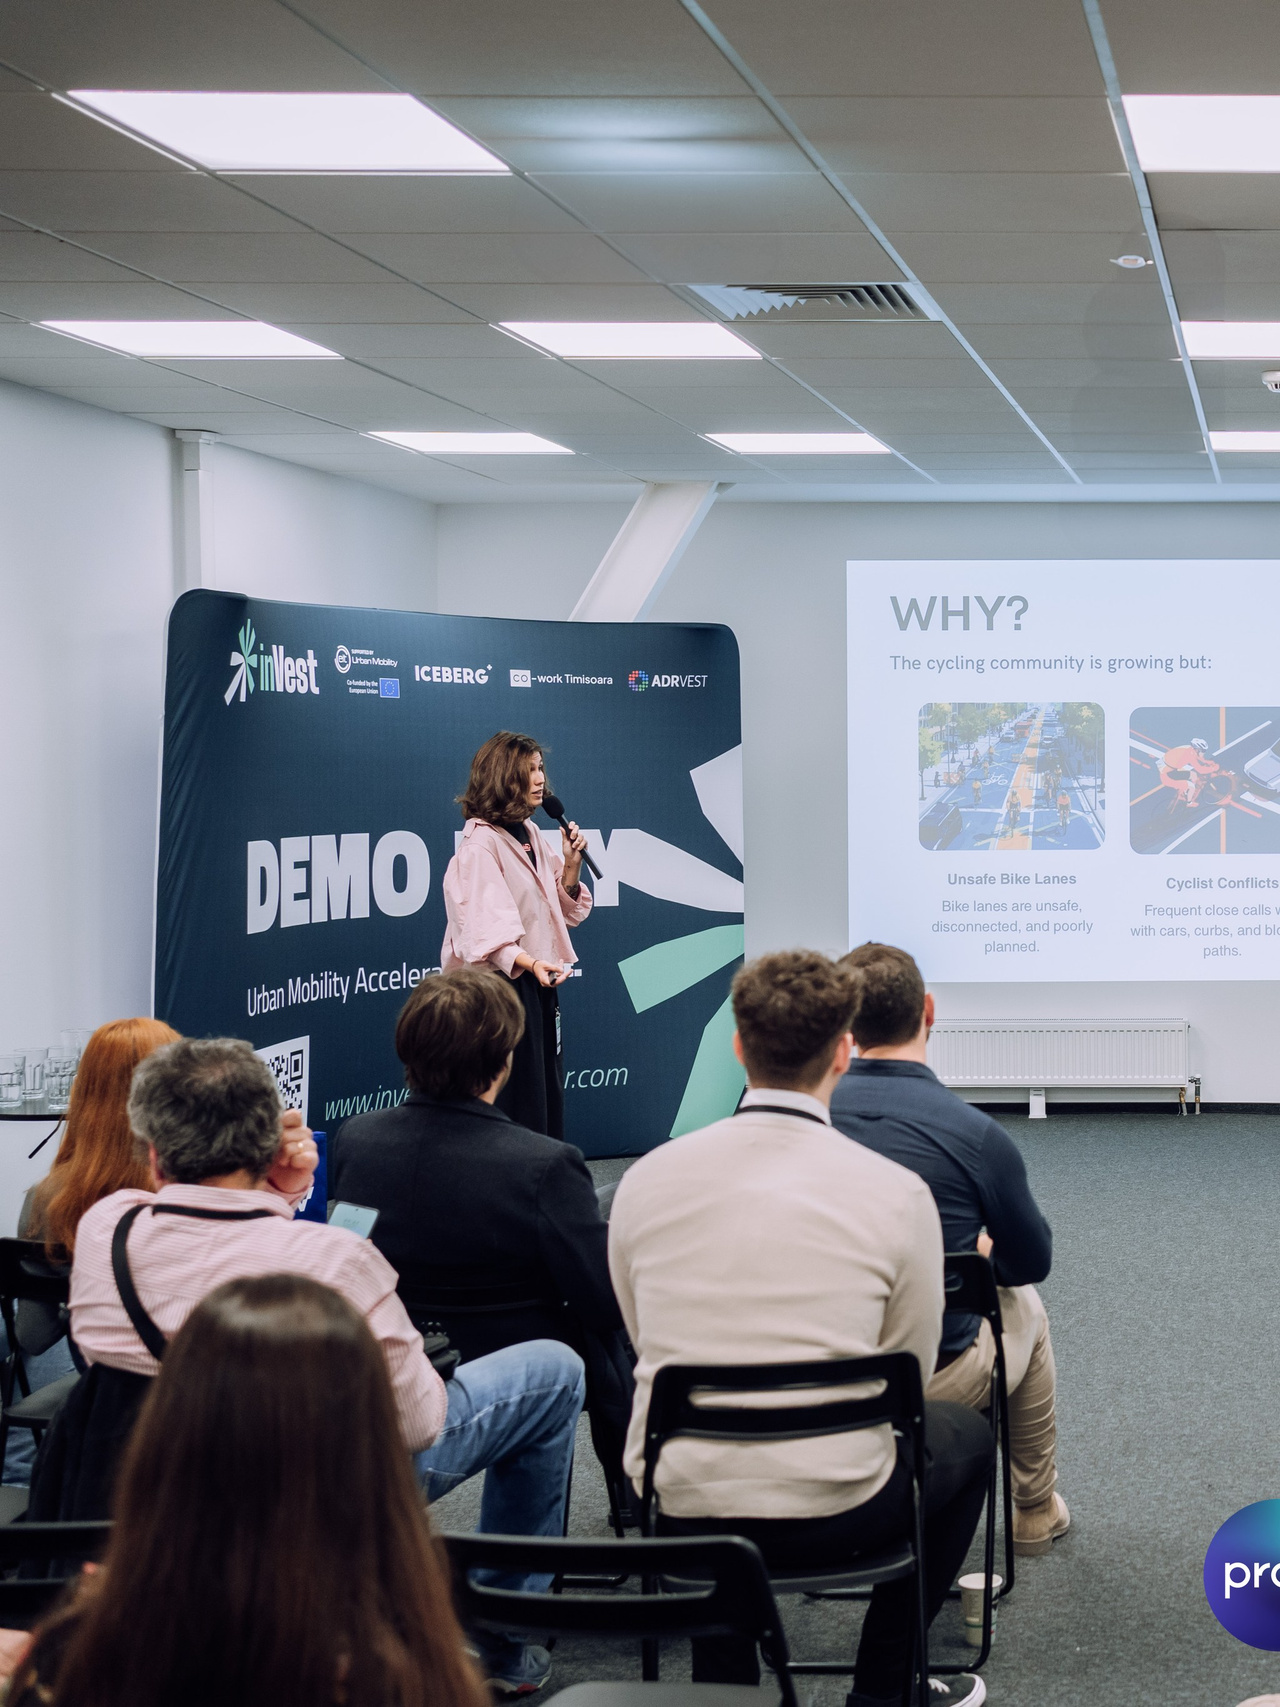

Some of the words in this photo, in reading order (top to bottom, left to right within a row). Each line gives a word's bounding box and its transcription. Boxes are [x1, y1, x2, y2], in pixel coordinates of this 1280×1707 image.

[890, 595, 1029, 631] WHY?
[260, 643, 320, 695] inVest
[351, 656, 371, 665] Urban
[372, 657, 398, 668] Mobility
[890, 655, 921, 670] The
[926, 654, 985, 674] cycling
[990, 655, 1085, 673] community
[1090, 655, 1102, 670] is
[1107, 655, 1174, 673] growing
[1179, 654, 1213, 670] but:
[564, 673, 613, 685] Timisoara
[651, 674, 708, 687] ADRVEST
[246, 830, 431, 935] DEMO
[947, 873, 997, 885] Unsafe
[1000, 873, 1031, 885] Bike
[1035, 872, 1077, 885] Lanes
[1166, 877, 1214, 892] Cyclist
[1217, 877, 1279, 889] Conflicts
[942, 900, 970, 912] Bike
[973, 900, 1008, 912] lanes
[1011, 902, 1032, 912] are
[1035, 899, 1082, 913] unsafe,
[1144, 904, 1202, 918] Frequent
[1204, 904, 1239, 916] close
[1242, 904, 1271, 916] calls
[931, 920, 1022, 933] disconnected,
[1025, 920, 1050, 932] and
[1053, 920, 1094, 934] poorly
[1130, 925, 1156, 937] with
[1159, 927, 1190, 938] cars,
[1194, 925, 1233, 938] curbs,
[1237, 925, 1261, 936] and
[984, 940, 1040, 955] planned.
[1203, 945, 1242, 959] paths.
[247, 982, 285, 1017] Urban
[288, 971, 352, 1005] Mobility
[354, 962, 443, 995] Acceler
